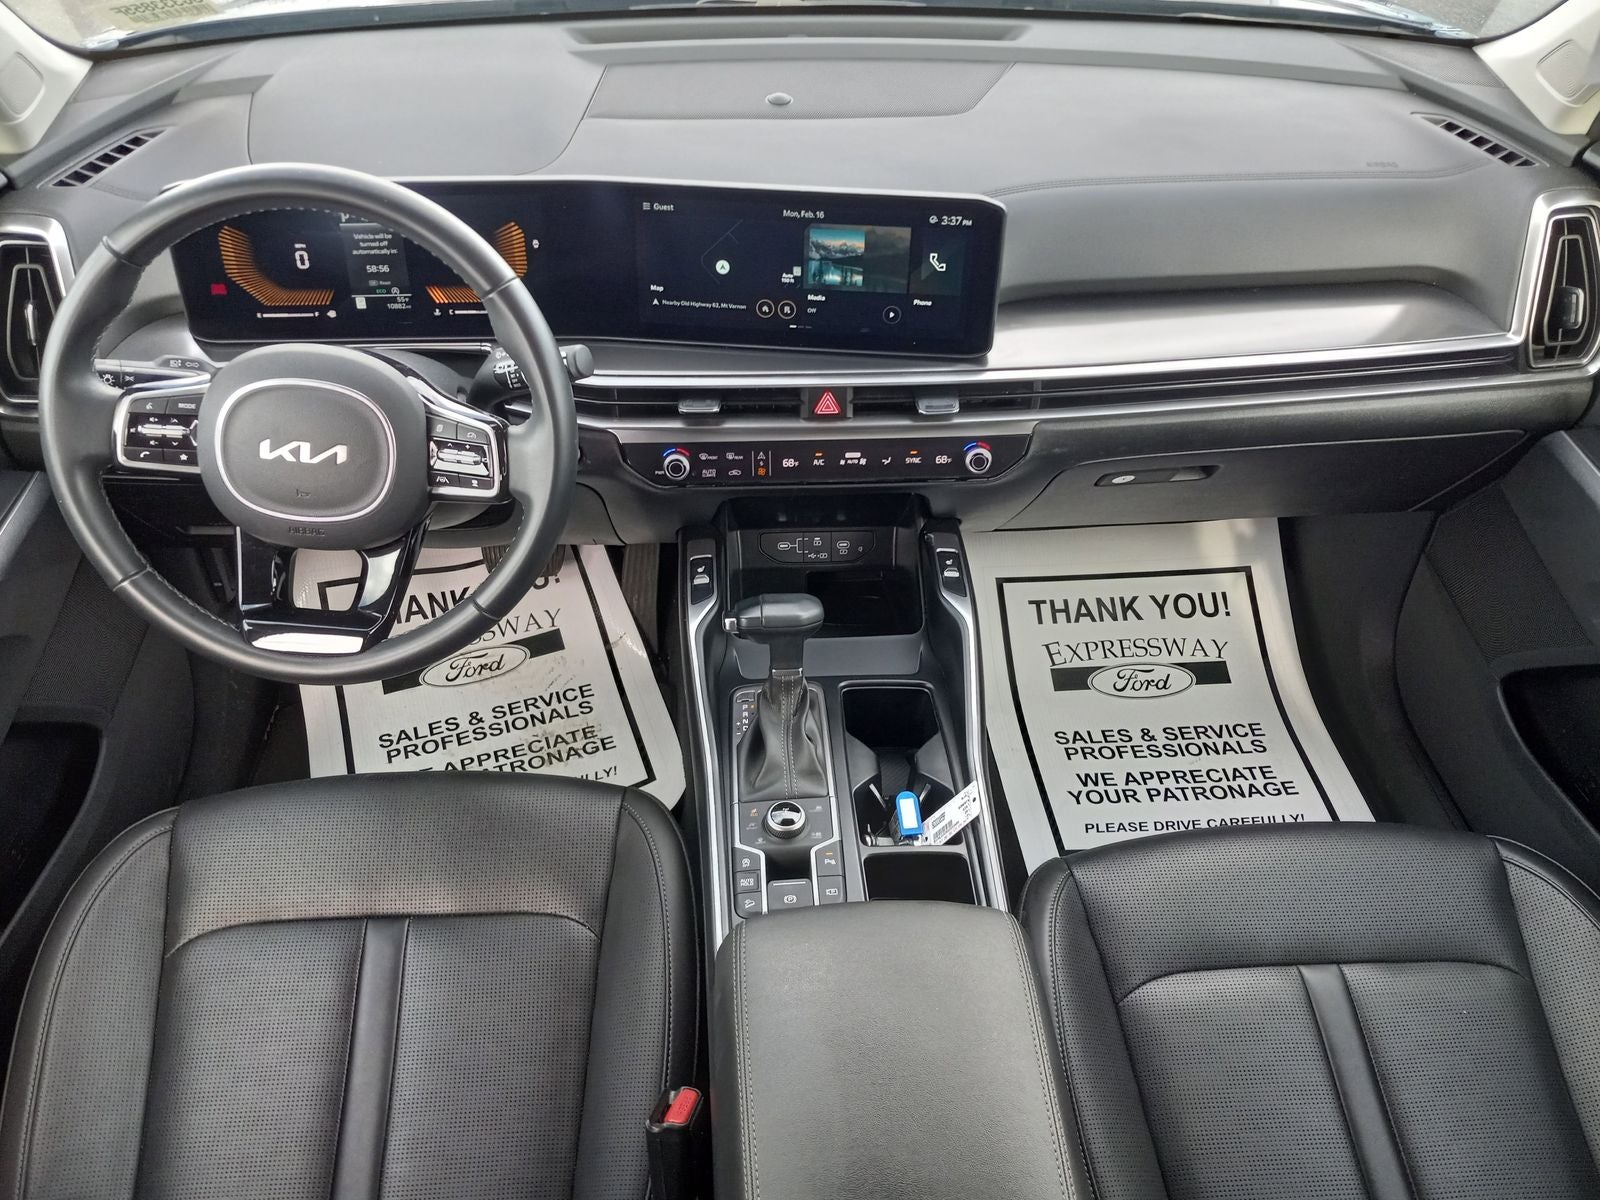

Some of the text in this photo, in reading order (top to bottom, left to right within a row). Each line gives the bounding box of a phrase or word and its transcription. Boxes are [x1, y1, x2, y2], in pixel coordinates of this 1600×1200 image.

[653, 203, 674, 211] Guest
[783, 209, 825, 219] Mon, Feb. 16
[941, 215, 962, 226] 3:37
[295, 250, 310, 269] 0
[366, 264, 390, 273] 58:56
[650, 284, 664, 293] Map
[807, 294, 826, 302] Media
[913, 299, 932, 307] Phone
[259, 438, 348, 465] KIA
[813, 458, 825, 466] A/C
[1028, 591, 1231, 625] THANK YOU!
[1041, 637, 1228, 667] EXPRESSWAY
[446, 651, 506, 683] Ford
[1112, 668, 1172, 692] Ford
[378, 683, 595, 748] SALES & SERVICE
[386, 701, 594, 763] PROFESSIONALS
[1054, 723, 1266, 745] SALES & SERVICE
[445, 725, 599, 771] APPRECIATE
[1063, 739, 1267, 761] PROFESSIONALS
[1076, 765, 1277, 787] WE APPRECIATE
[1067, 781, 1299, 805] YOUR PATRONAGE
[1085, 821, 1149, 834] PLEASE
[1153, 819, 1201, 832] DRIVE
